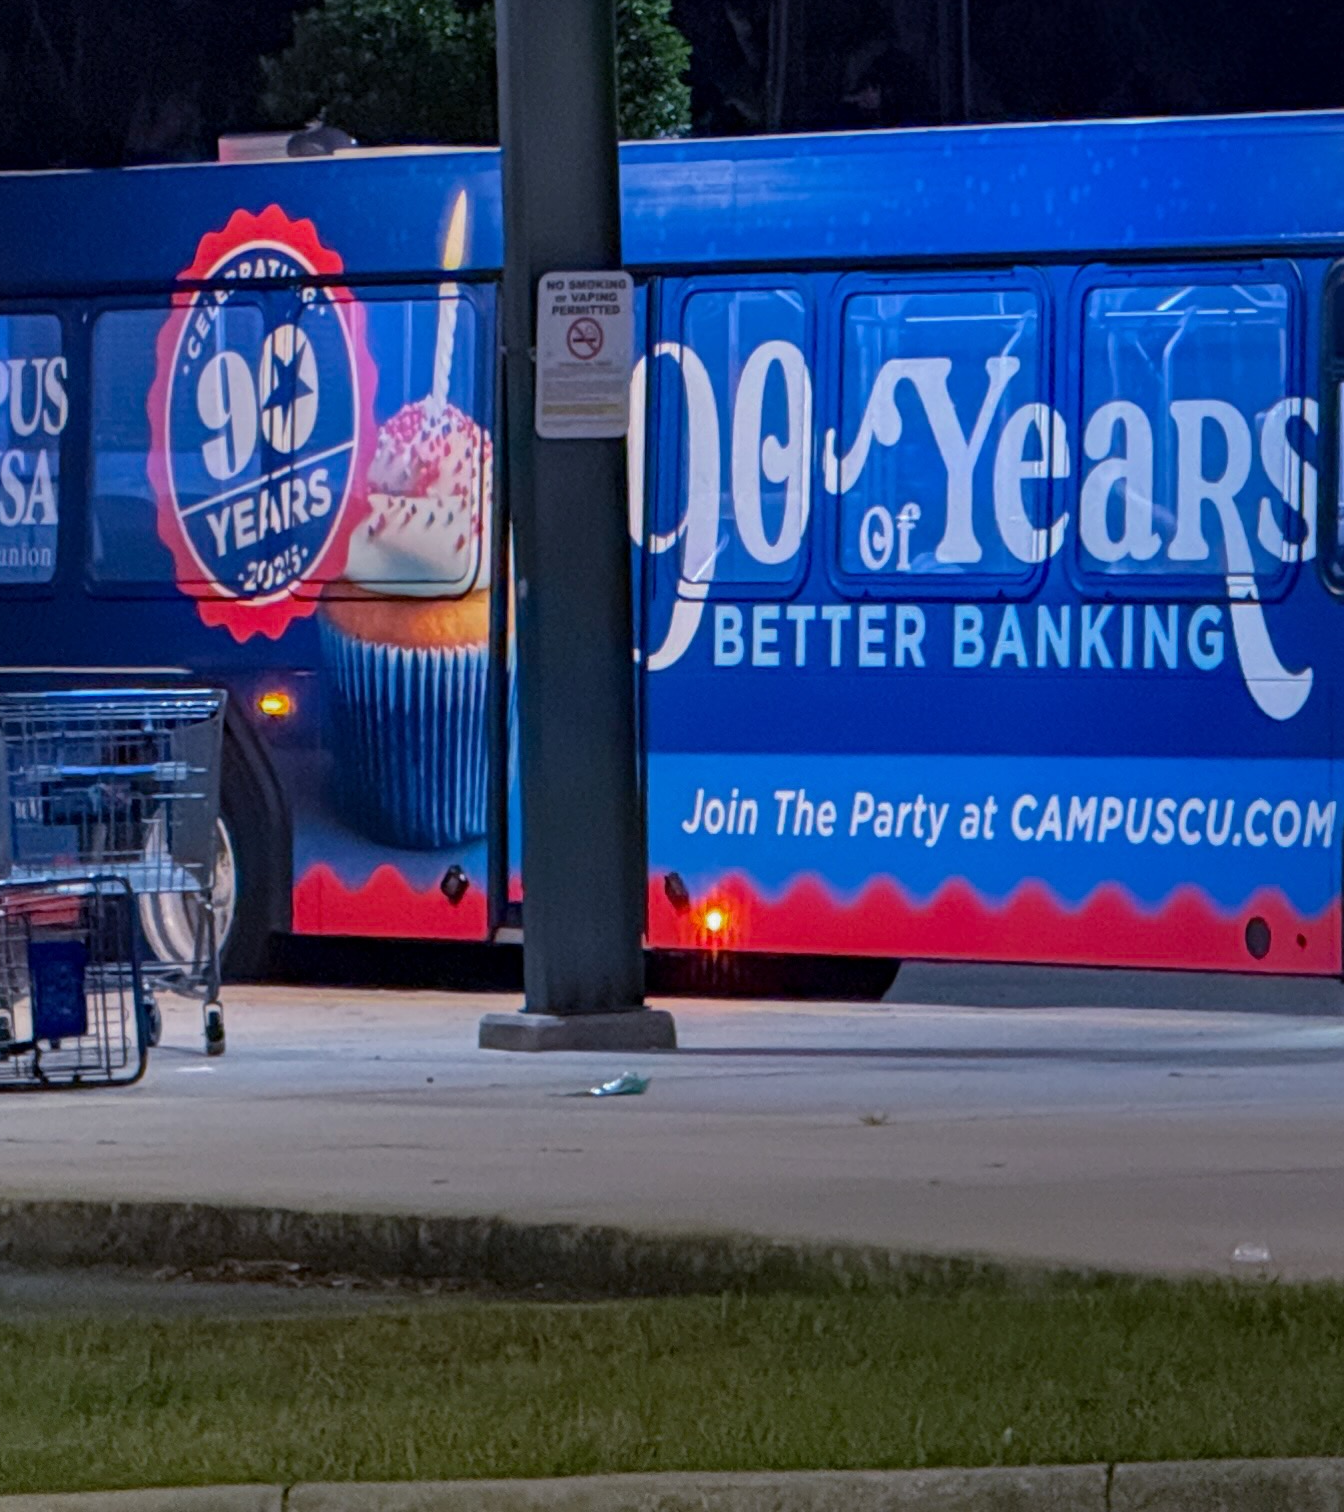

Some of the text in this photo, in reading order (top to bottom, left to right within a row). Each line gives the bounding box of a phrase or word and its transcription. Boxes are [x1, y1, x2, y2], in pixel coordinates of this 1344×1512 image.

[546, 279, 628, 291] NO SMOKING
[551, 305, 621, 316] PERMITTED
[555, 292, 618, 303] or VAPING
[196, 324, 319, 480] 90
[206, 468, 332, 557] YEARS
[628, 339, 813, 672] 90
[713, 604, 1227, 671] BETTER BANKING
[681, 789, 1338, 849] Join The Party at CAMPUSCU.COM
